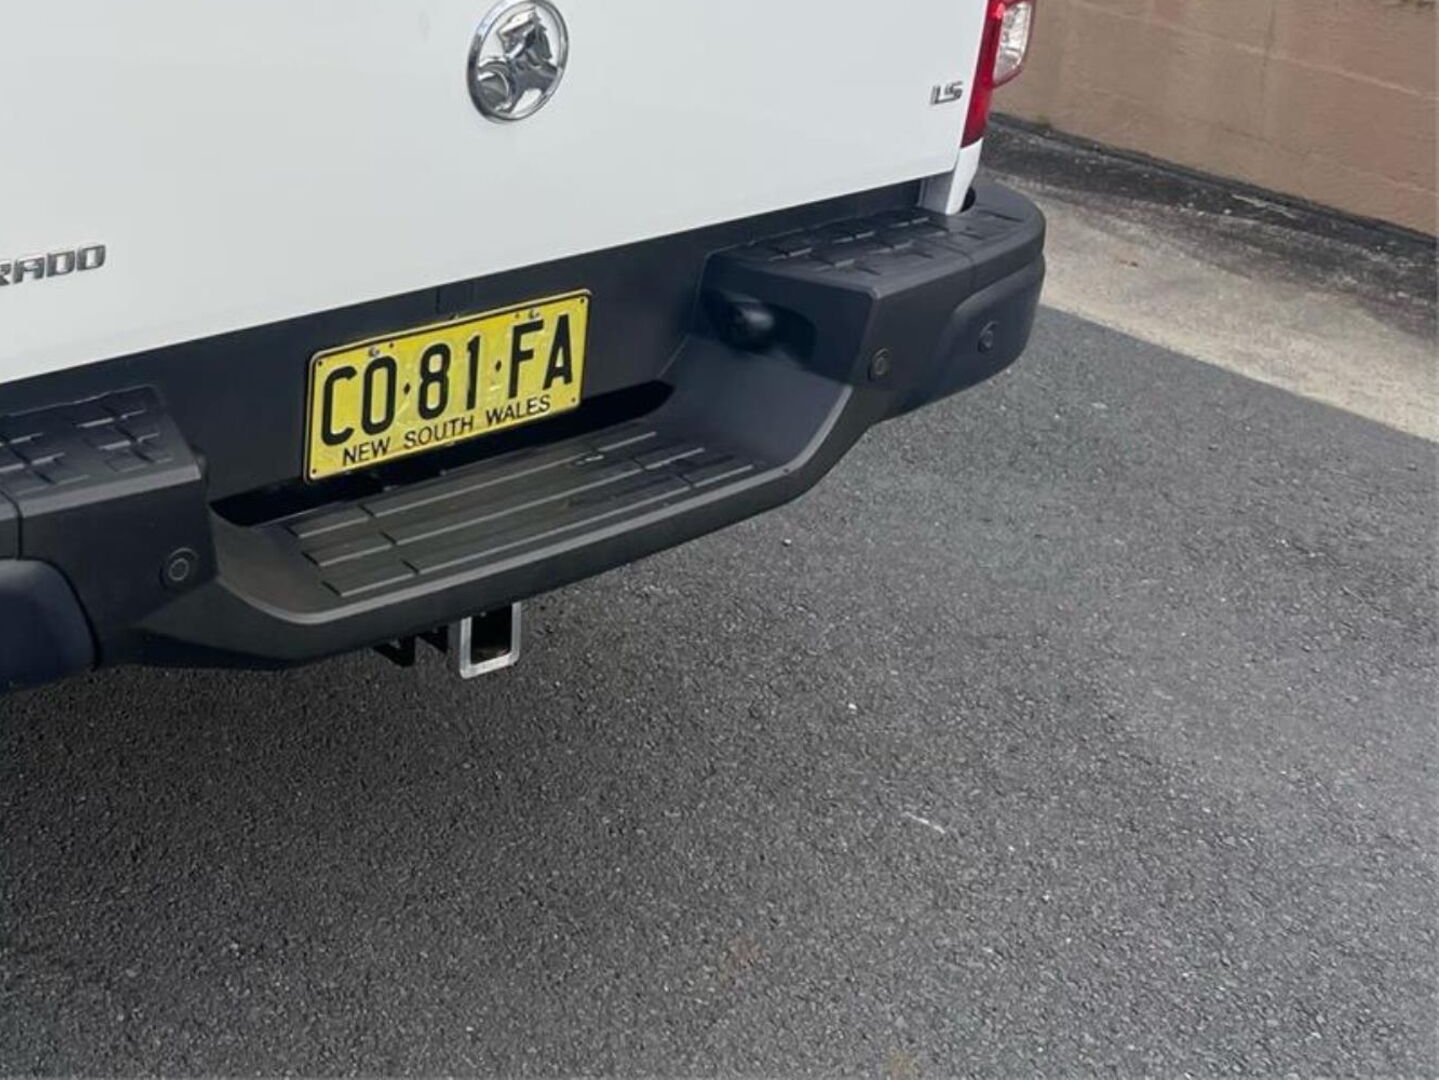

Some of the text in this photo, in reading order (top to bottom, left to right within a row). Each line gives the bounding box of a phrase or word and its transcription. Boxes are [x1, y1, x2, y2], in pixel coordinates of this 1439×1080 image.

[930, 81, 963, 104] LS
[342, 394, 551, 467] NEW SOUTH WALES
